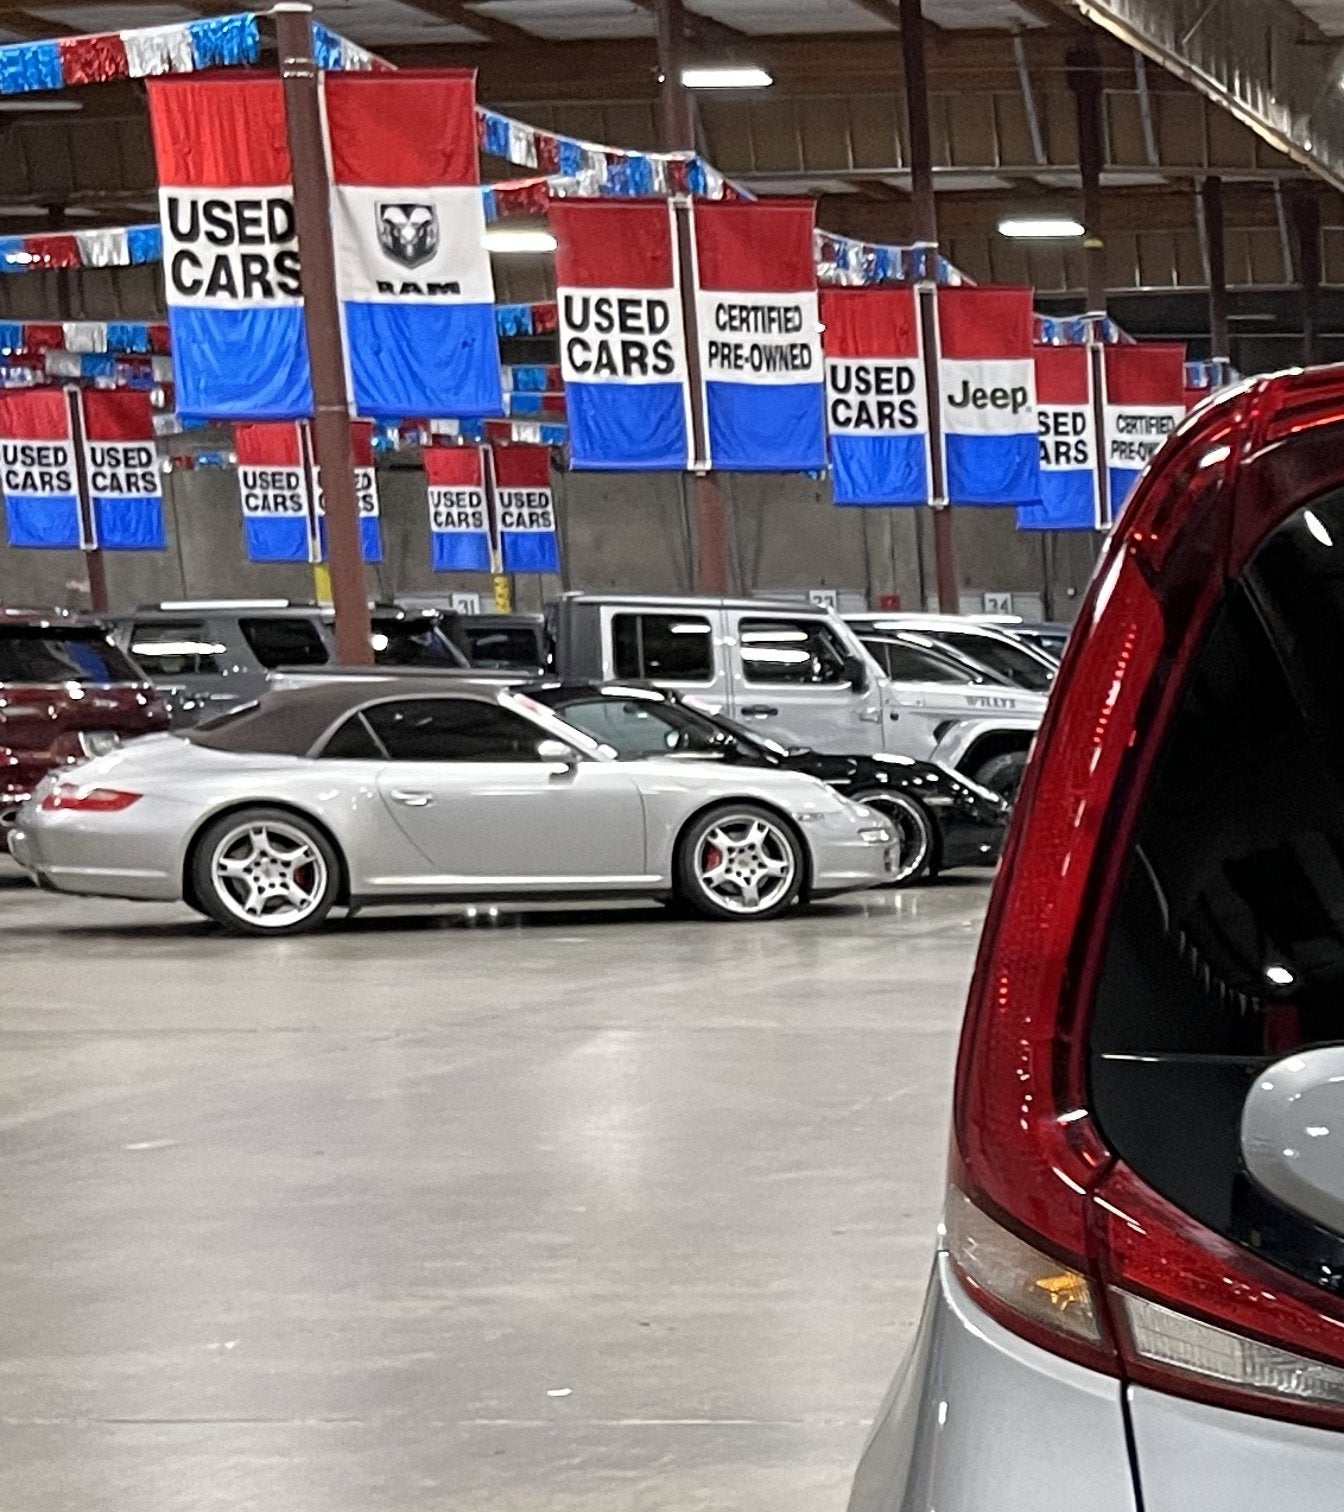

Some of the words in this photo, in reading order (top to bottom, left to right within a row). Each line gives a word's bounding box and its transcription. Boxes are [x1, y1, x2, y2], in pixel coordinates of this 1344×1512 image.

[167, 197, 297, 247] USED
[171, 249, 300, 299] CARS
[376, 280, 461, 295] RAM
[564, 295, 670, 335] USED
[715, 303, 803, 334] CERTIFIED
[567, 337, 676, 376] CARS
[708, 341, 812, 372] PRE-OWNED
[830, 365, 916, 395] USED
[948, 380, 1028, 414] Jeep
[831, 398, 918, 429] CARS
[1038, 412, 1086, 436] SED
[1116, 414, 1175, 434] CERTIFIED
[2, 445, 68, 467] USED
[90, 447, 153, 468] USED
[1039, 439, 1089, 464] ARS
[6, 470, 72, 491] CARS
[92, 471, 158, 493] CARS
[243, 471, 300, 490] USED
[245, 493, 303, 512] CARS
[430, 491, 482, 508] USED
[500, 492, 549, 509] USED
[433, 511, 483, 528] CARS
[502, 512, 552, 528] CARS
